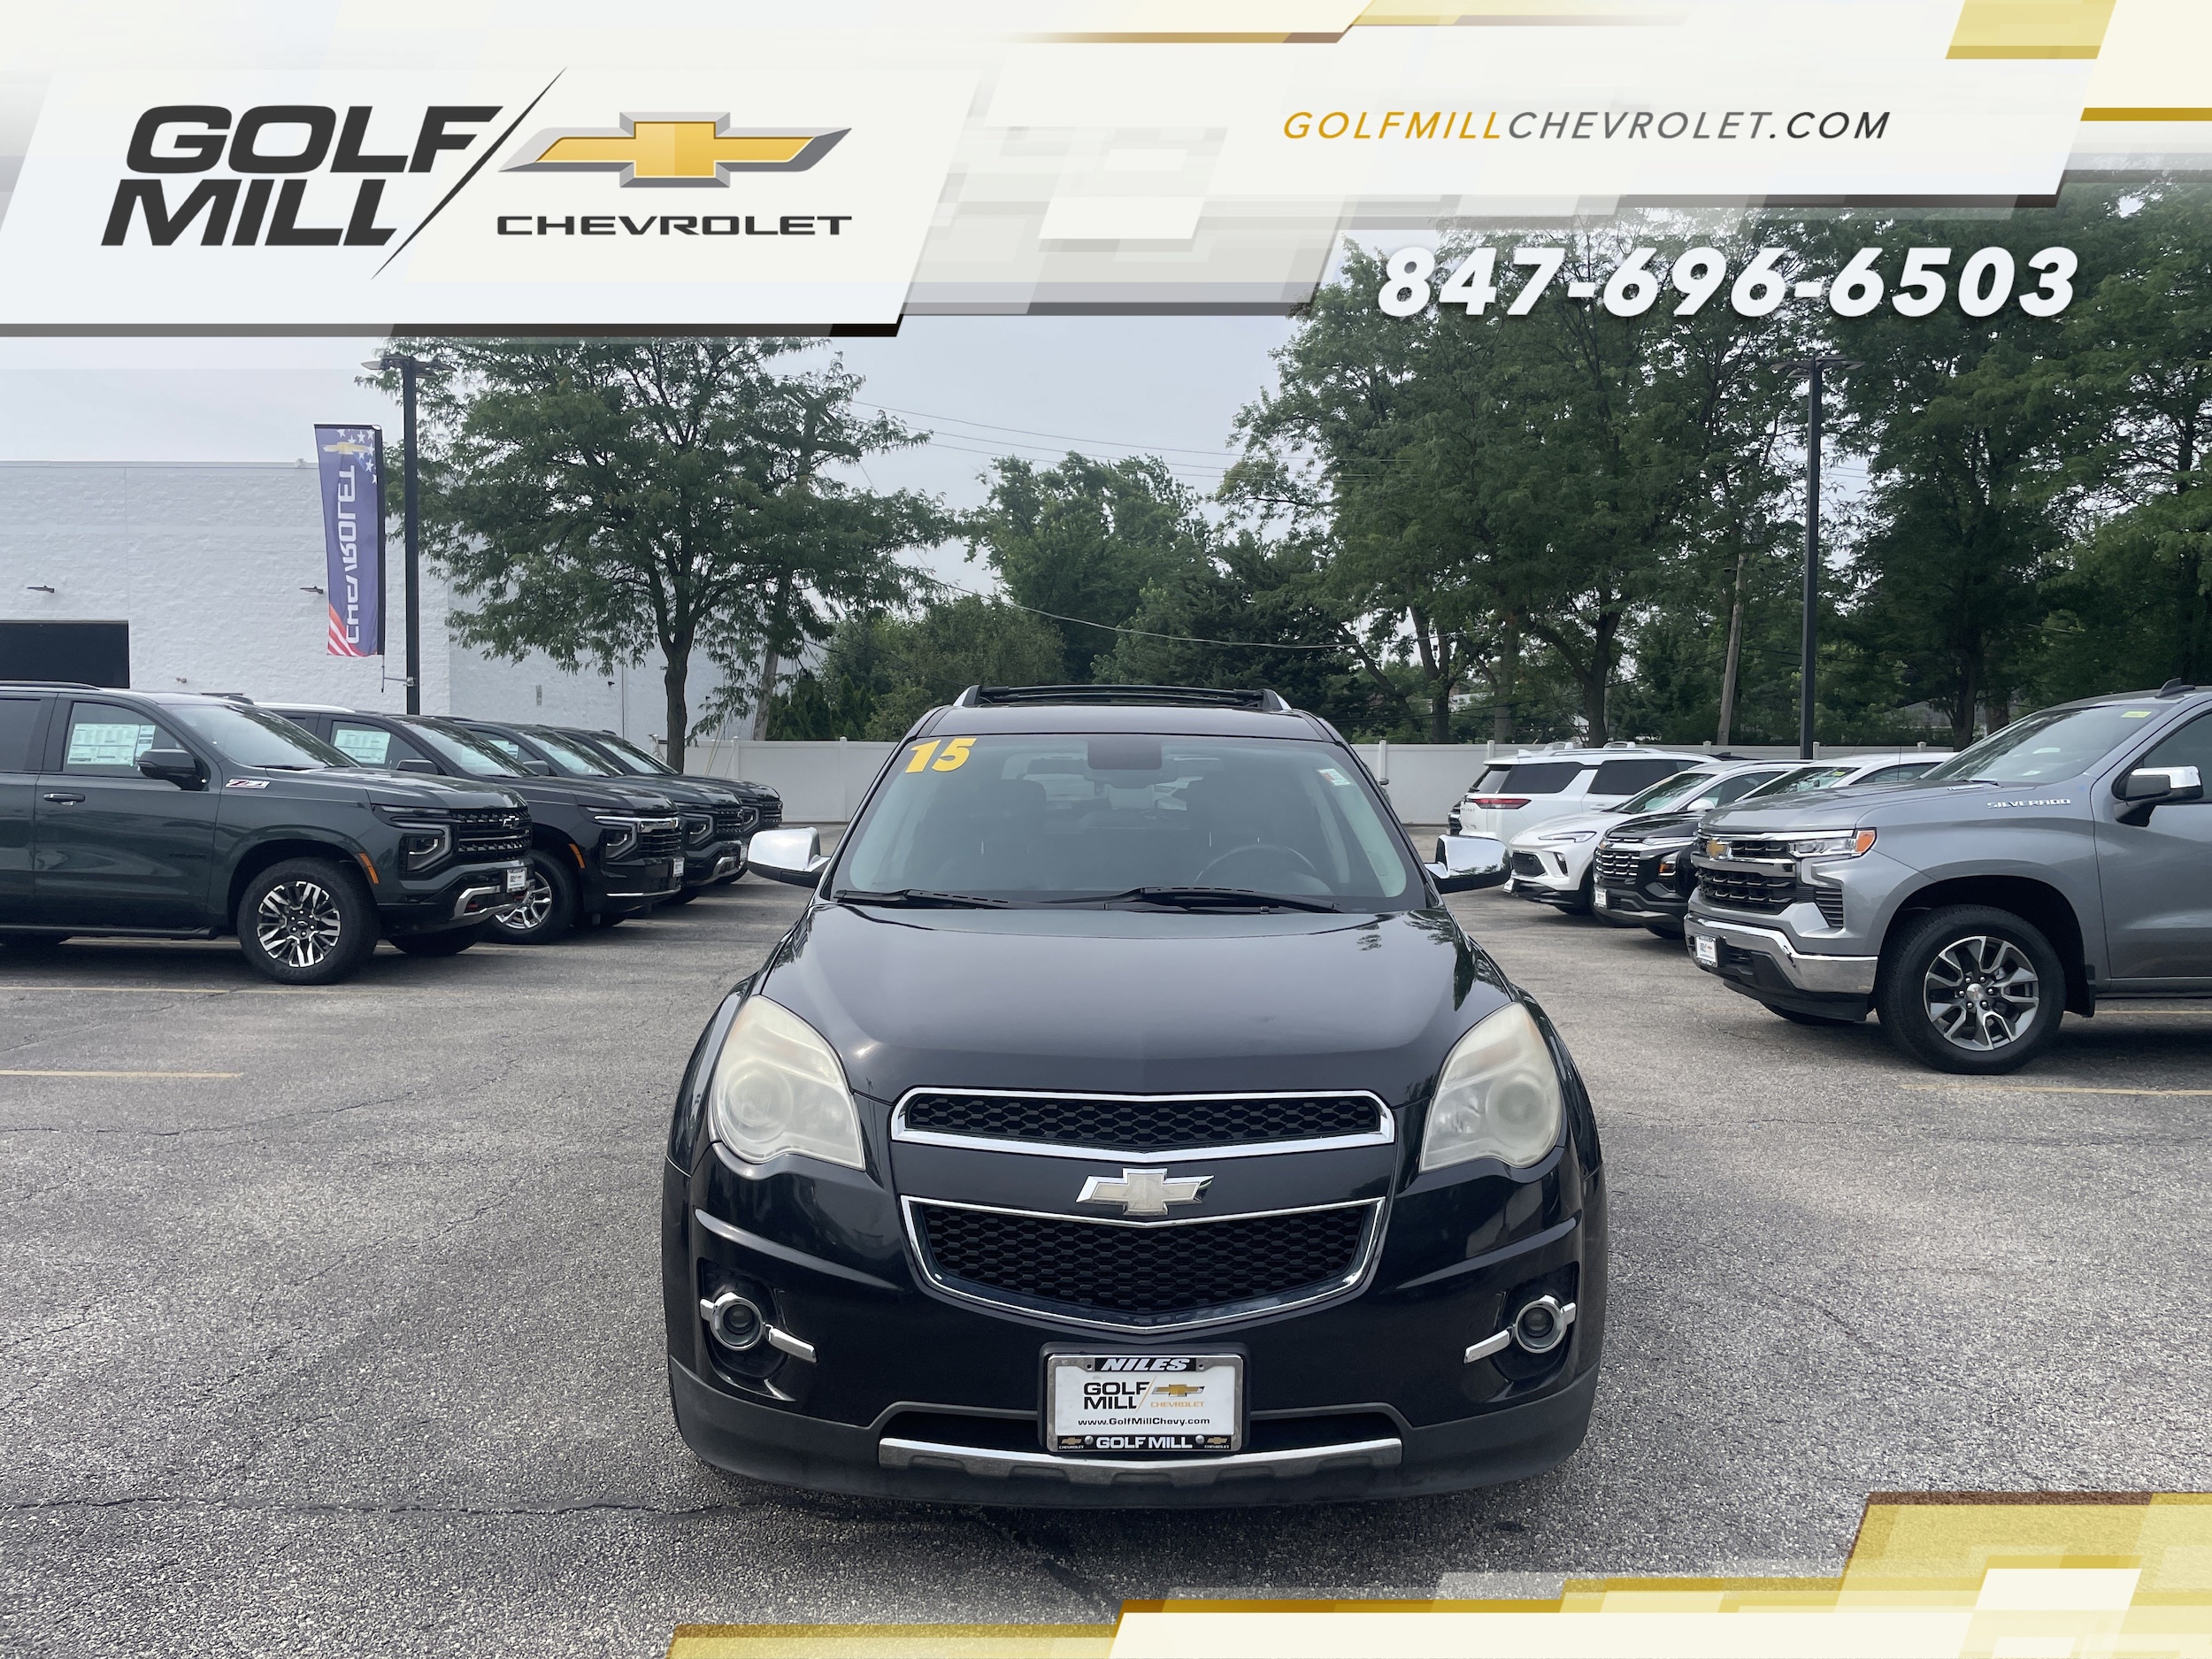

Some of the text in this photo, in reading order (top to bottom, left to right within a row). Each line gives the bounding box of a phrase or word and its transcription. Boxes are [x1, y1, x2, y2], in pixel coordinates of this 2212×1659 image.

[905, 737, 977, 773] 15
[1987, 799, 2071, 809] SILVERADO
[1101, 1358, 1189, 1371] NILES
[1084, 1381, 1150, 1395] GOLF
[1084, 1396, 1137, 1409] MILL
[1078, 1417, 1210, 1426] www.GolfMillChevy.com
[1095, 1437, 1194, 1448] GOLF MILL
